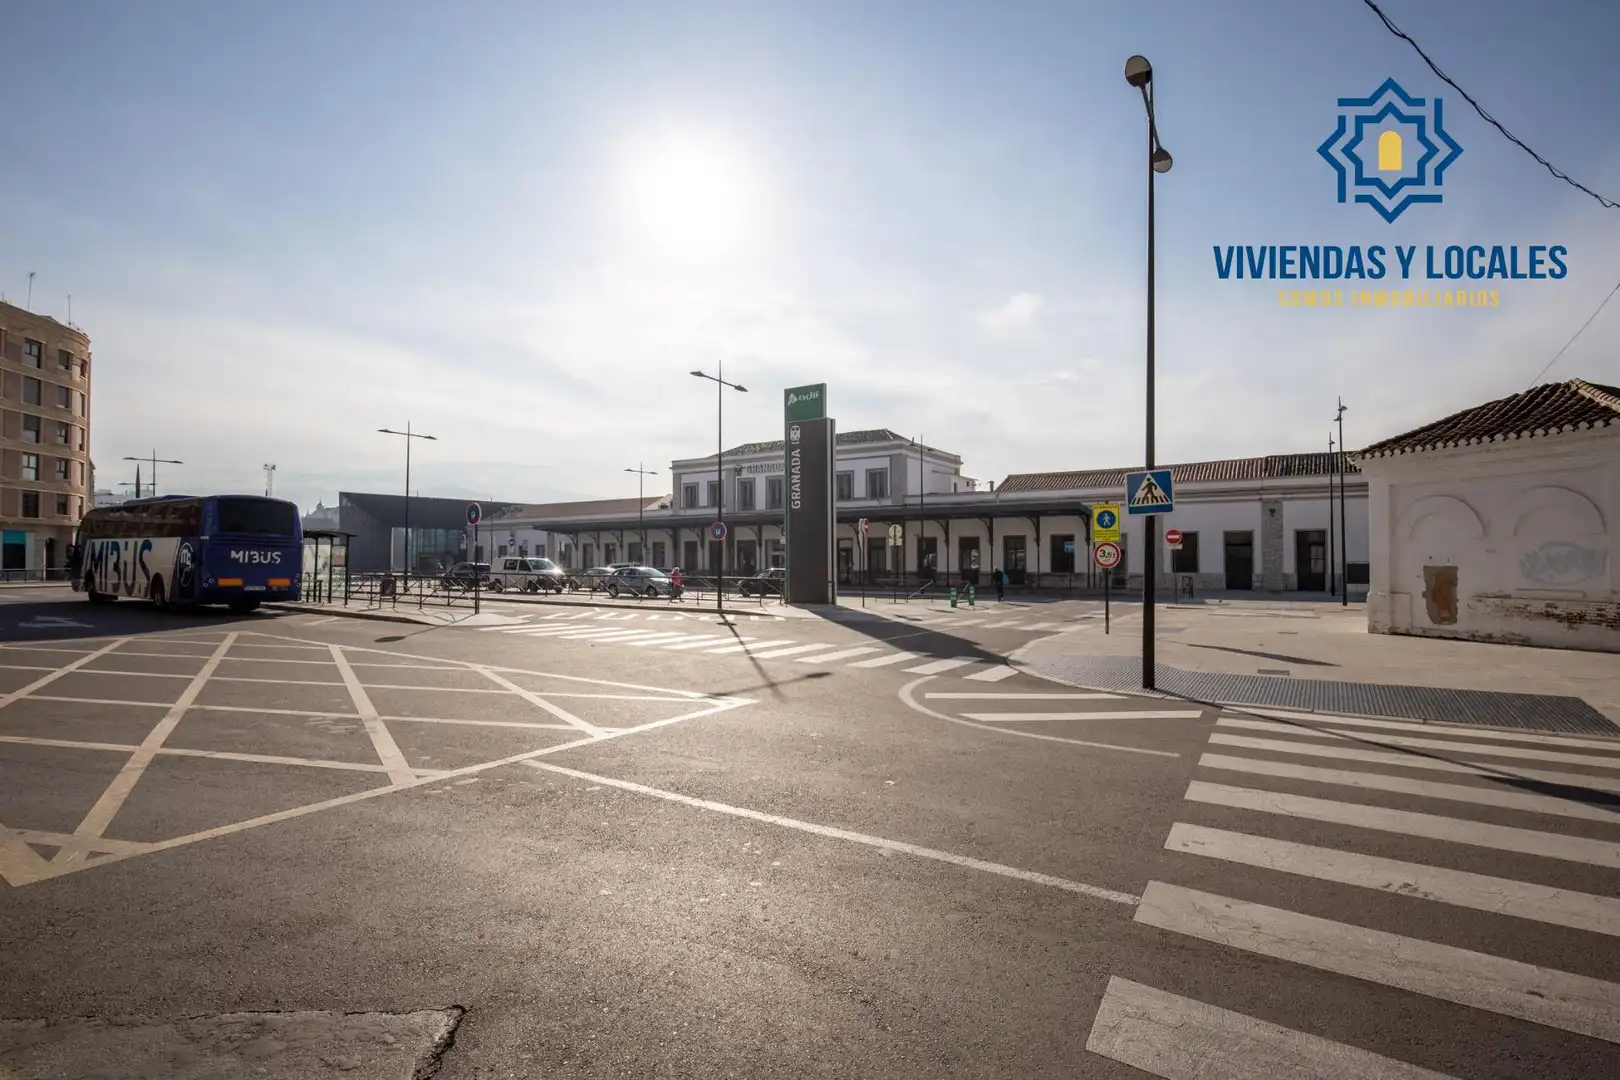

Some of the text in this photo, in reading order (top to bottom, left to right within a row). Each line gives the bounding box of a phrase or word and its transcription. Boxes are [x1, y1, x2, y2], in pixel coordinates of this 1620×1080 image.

[791, 448, 801, 510] GRANADA
[89, 539, 153, 597] MIBUS
[230, 550, 282, 564] MIBUS
